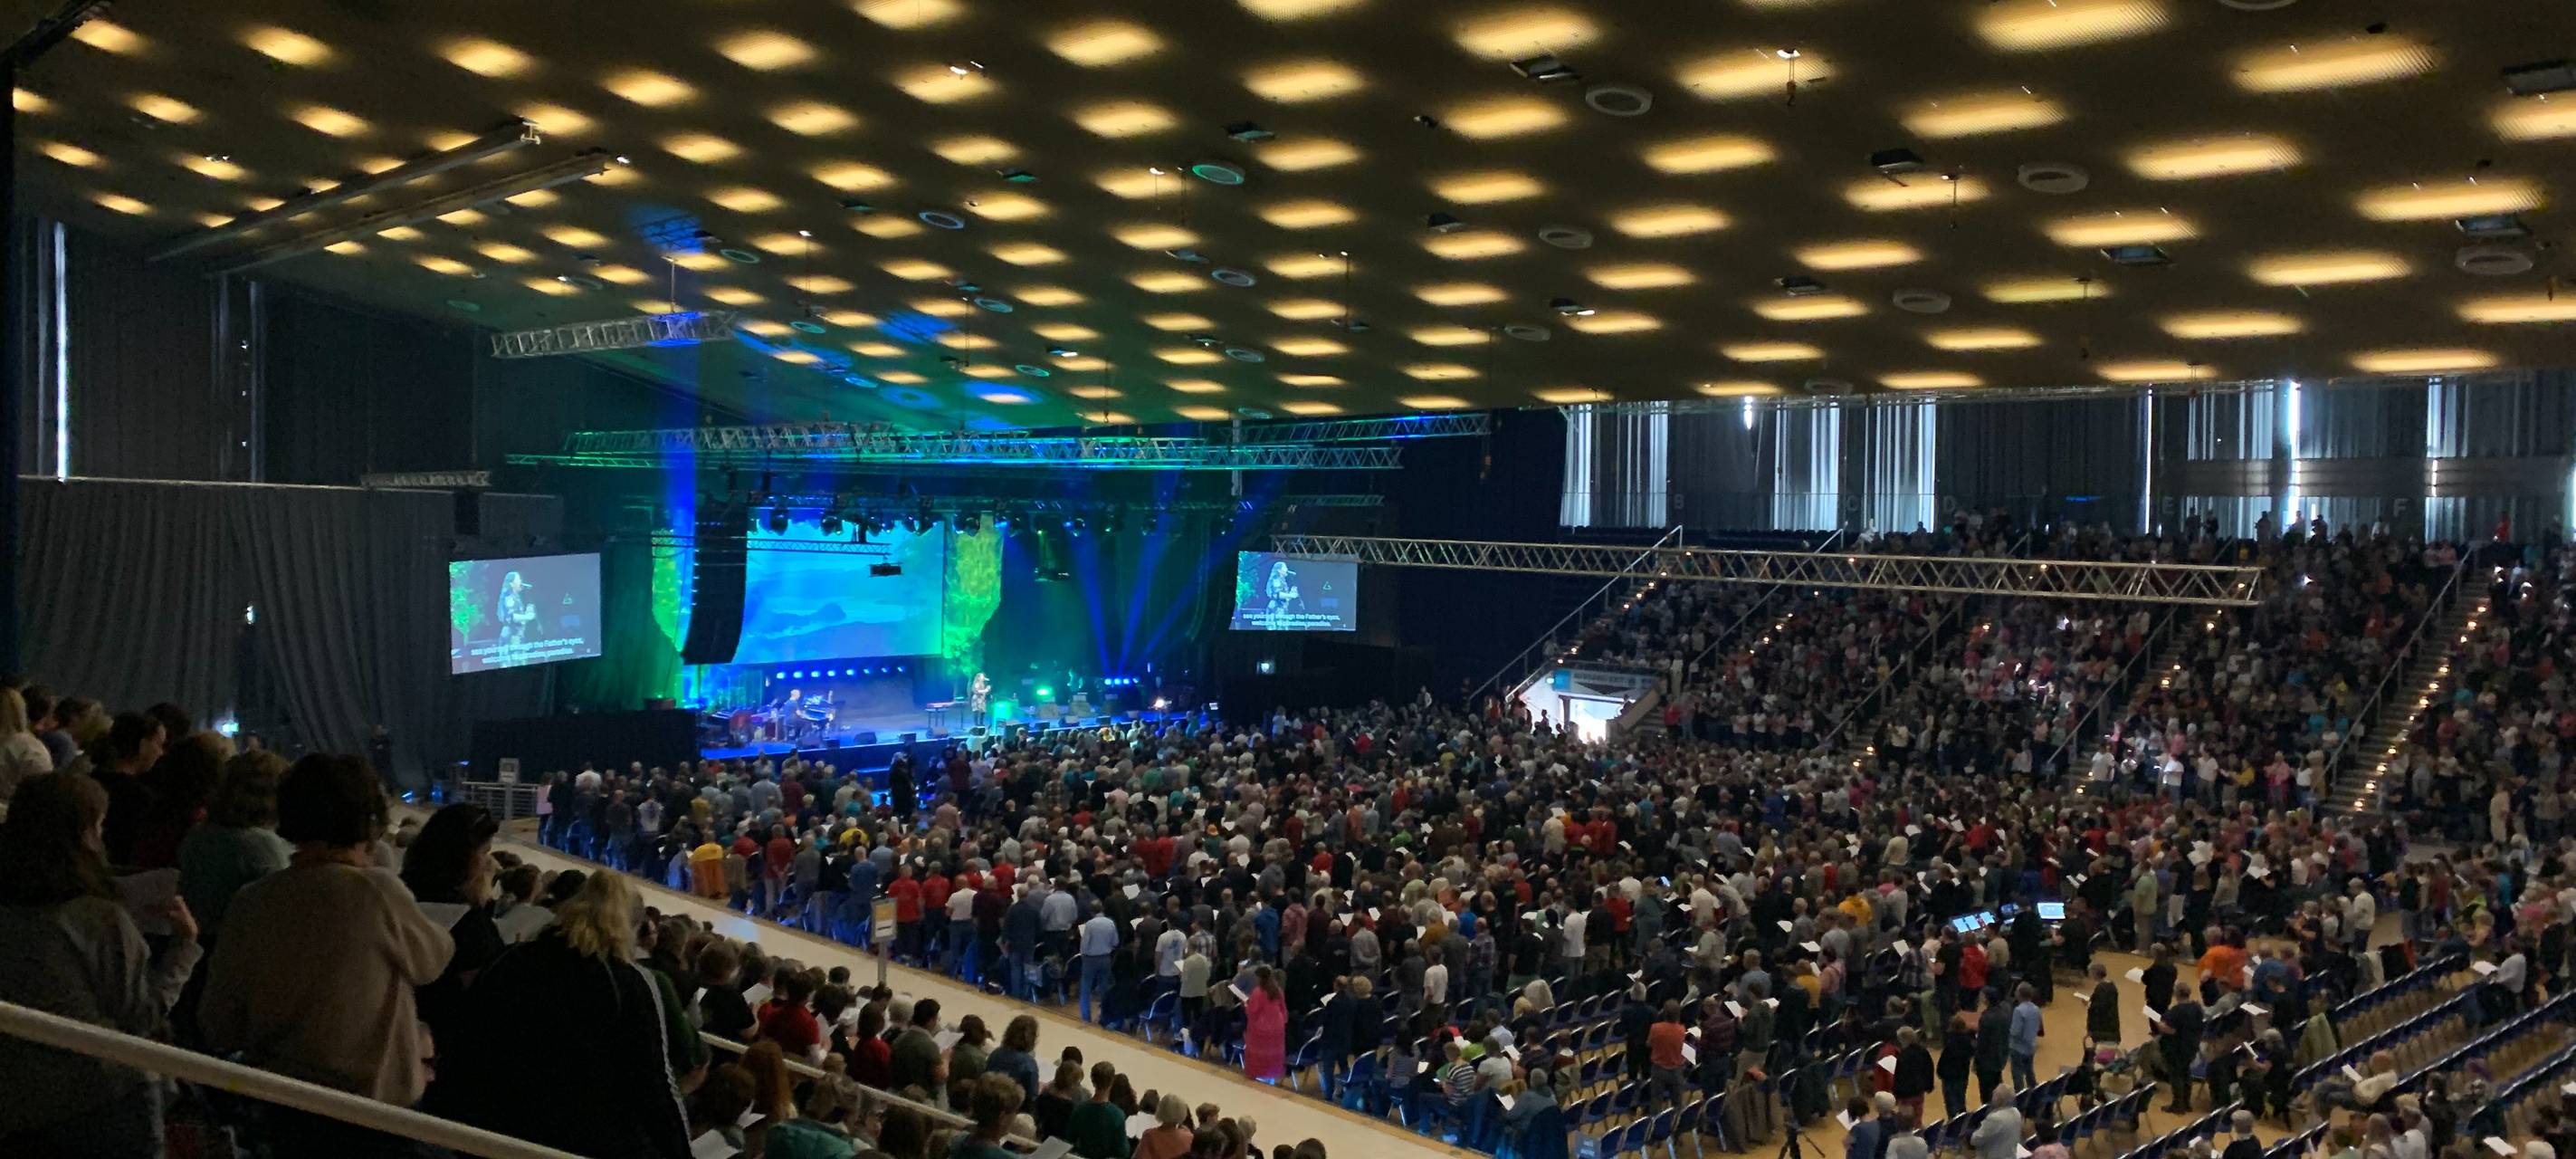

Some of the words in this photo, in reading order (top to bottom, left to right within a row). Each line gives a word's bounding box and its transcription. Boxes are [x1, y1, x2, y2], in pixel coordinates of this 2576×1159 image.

[1673, 494, 1685, 510] B
[1943, 495, 1956, 512] D
[2162, 497, 2174, 514] E
[2393, 498, 2407, 516] F
